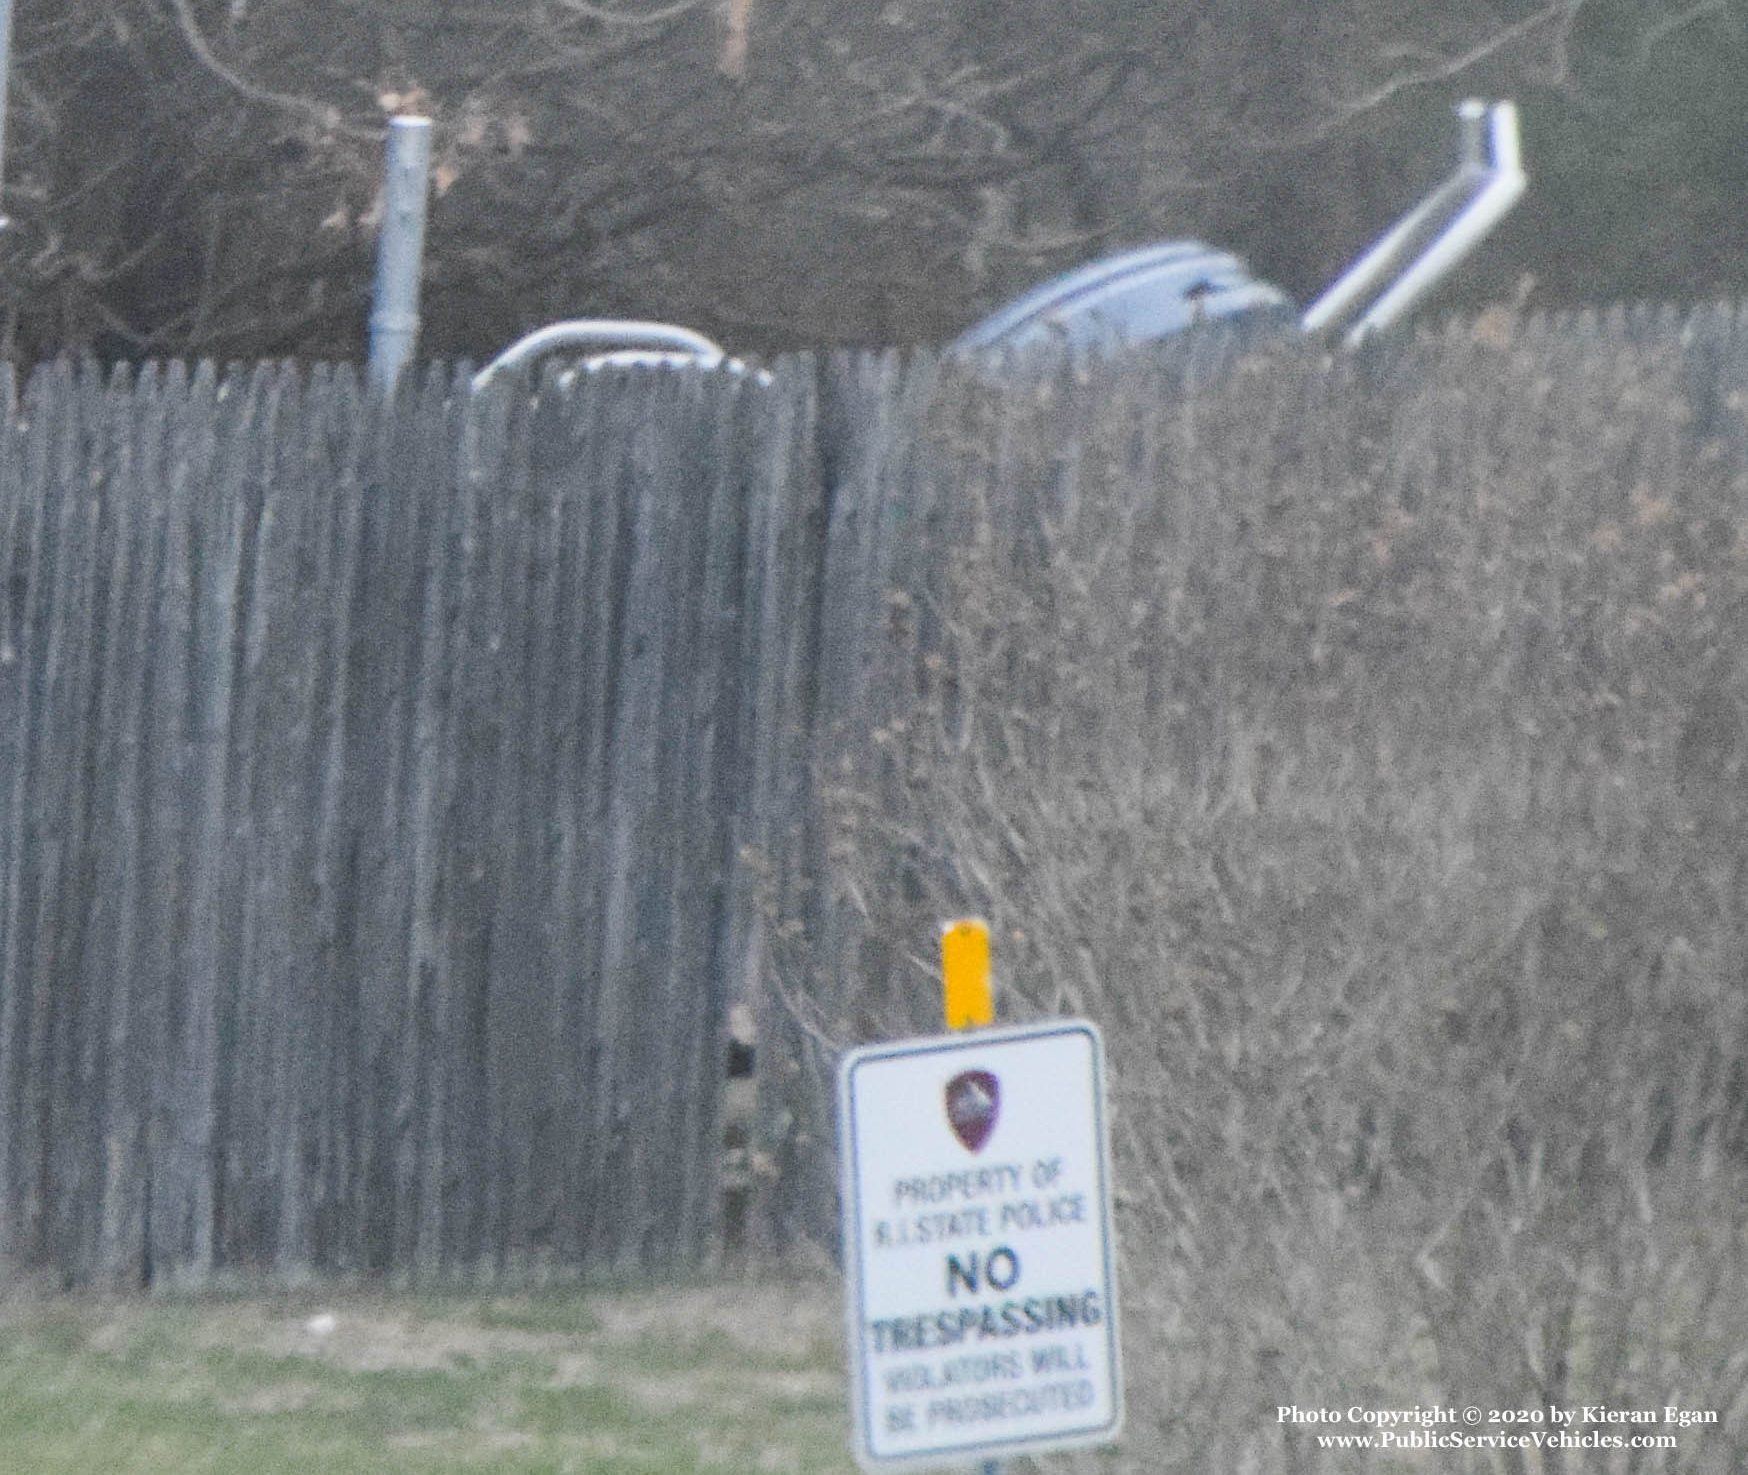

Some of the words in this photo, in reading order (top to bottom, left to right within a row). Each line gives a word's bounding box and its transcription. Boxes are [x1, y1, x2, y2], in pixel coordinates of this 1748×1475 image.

[893, 1165, 1022, 1208] PROPERTY
[1031, 1157, 1063, 1189] OF
[999, 1193, 1087, 1231] POLICE
[947, 1245, 1021, 1297] NO
[871, 1289, 1102, 1354] TRESPASSING
[884, 1347, 1024, 1393] VIOLATORS
[1031, 1342, 1090, 1373] WILL
